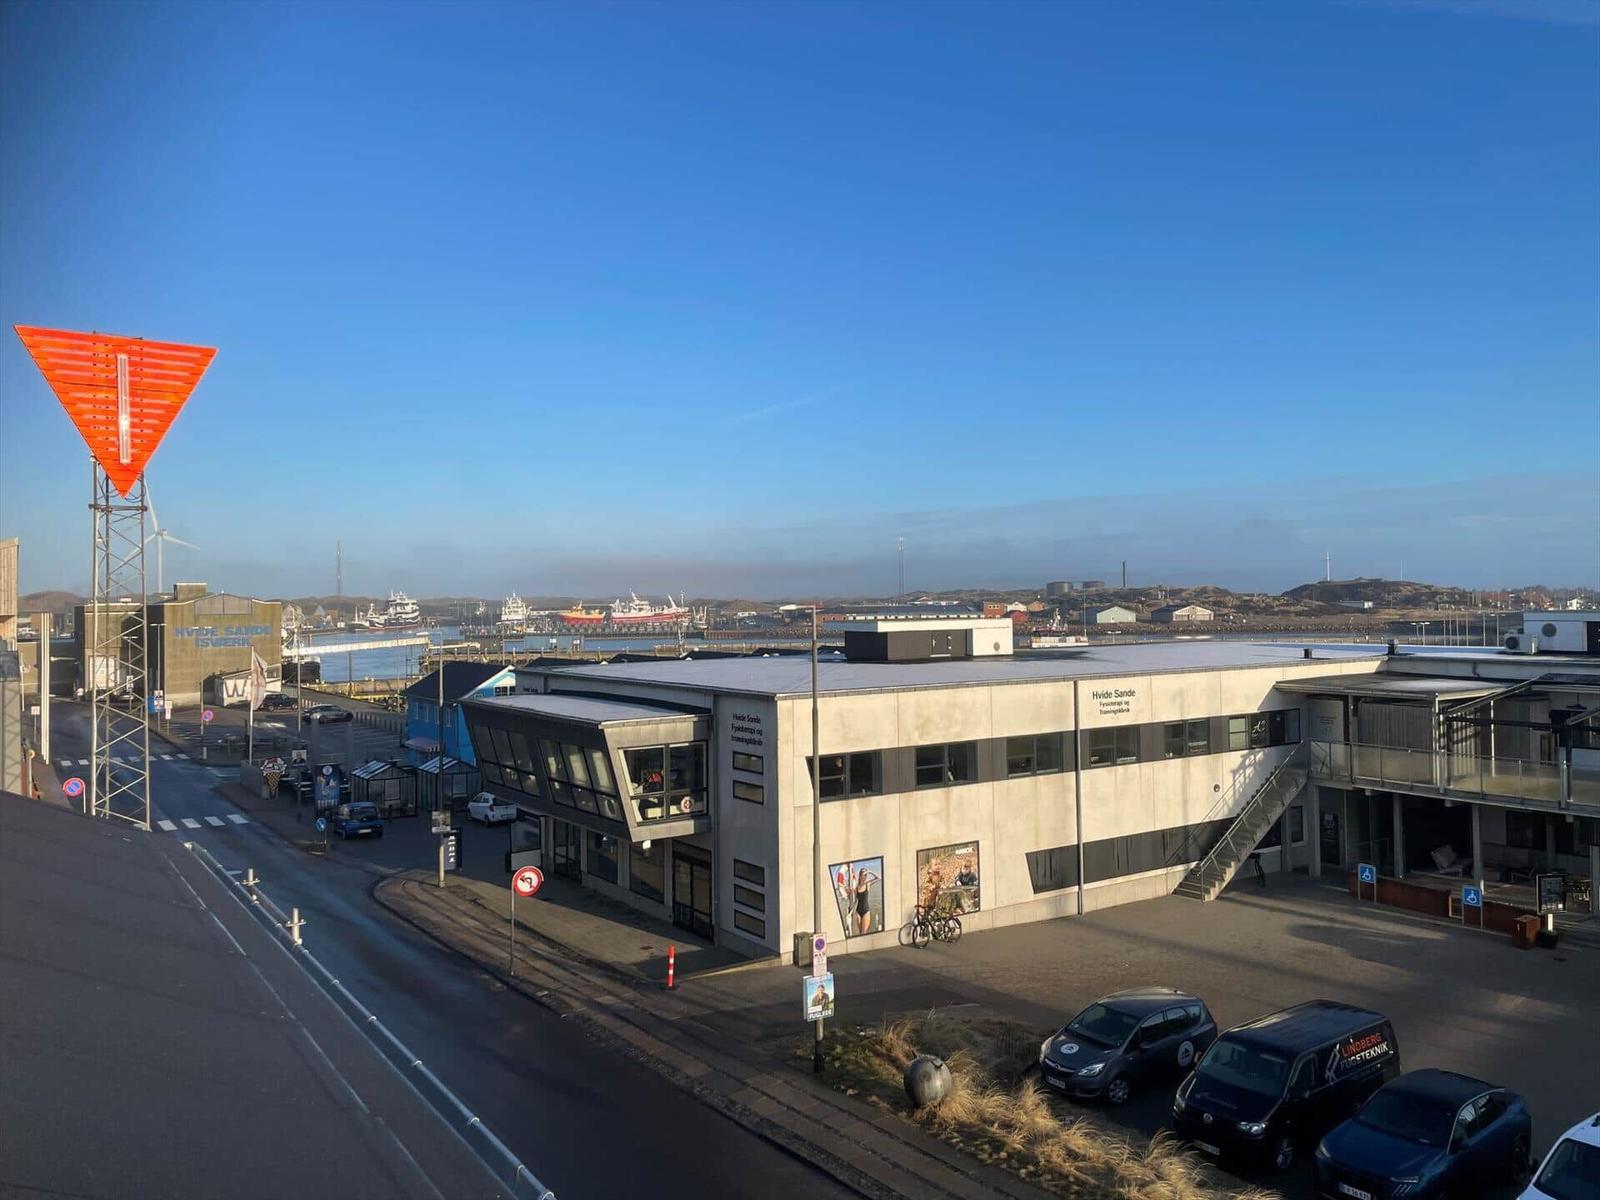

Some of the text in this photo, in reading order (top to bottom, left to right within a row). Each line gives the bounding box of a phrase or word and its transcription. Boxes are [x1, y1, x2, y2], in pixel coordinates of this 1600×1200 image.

[1092, 688, 1136, 700] Hvide Sande
[732, 712, 761, 724] Hvide Sande
[1341, 1032, 1383, 1057] LINDBERG
[1339, 1041, 1389, 1071] FUGETEKNIK
